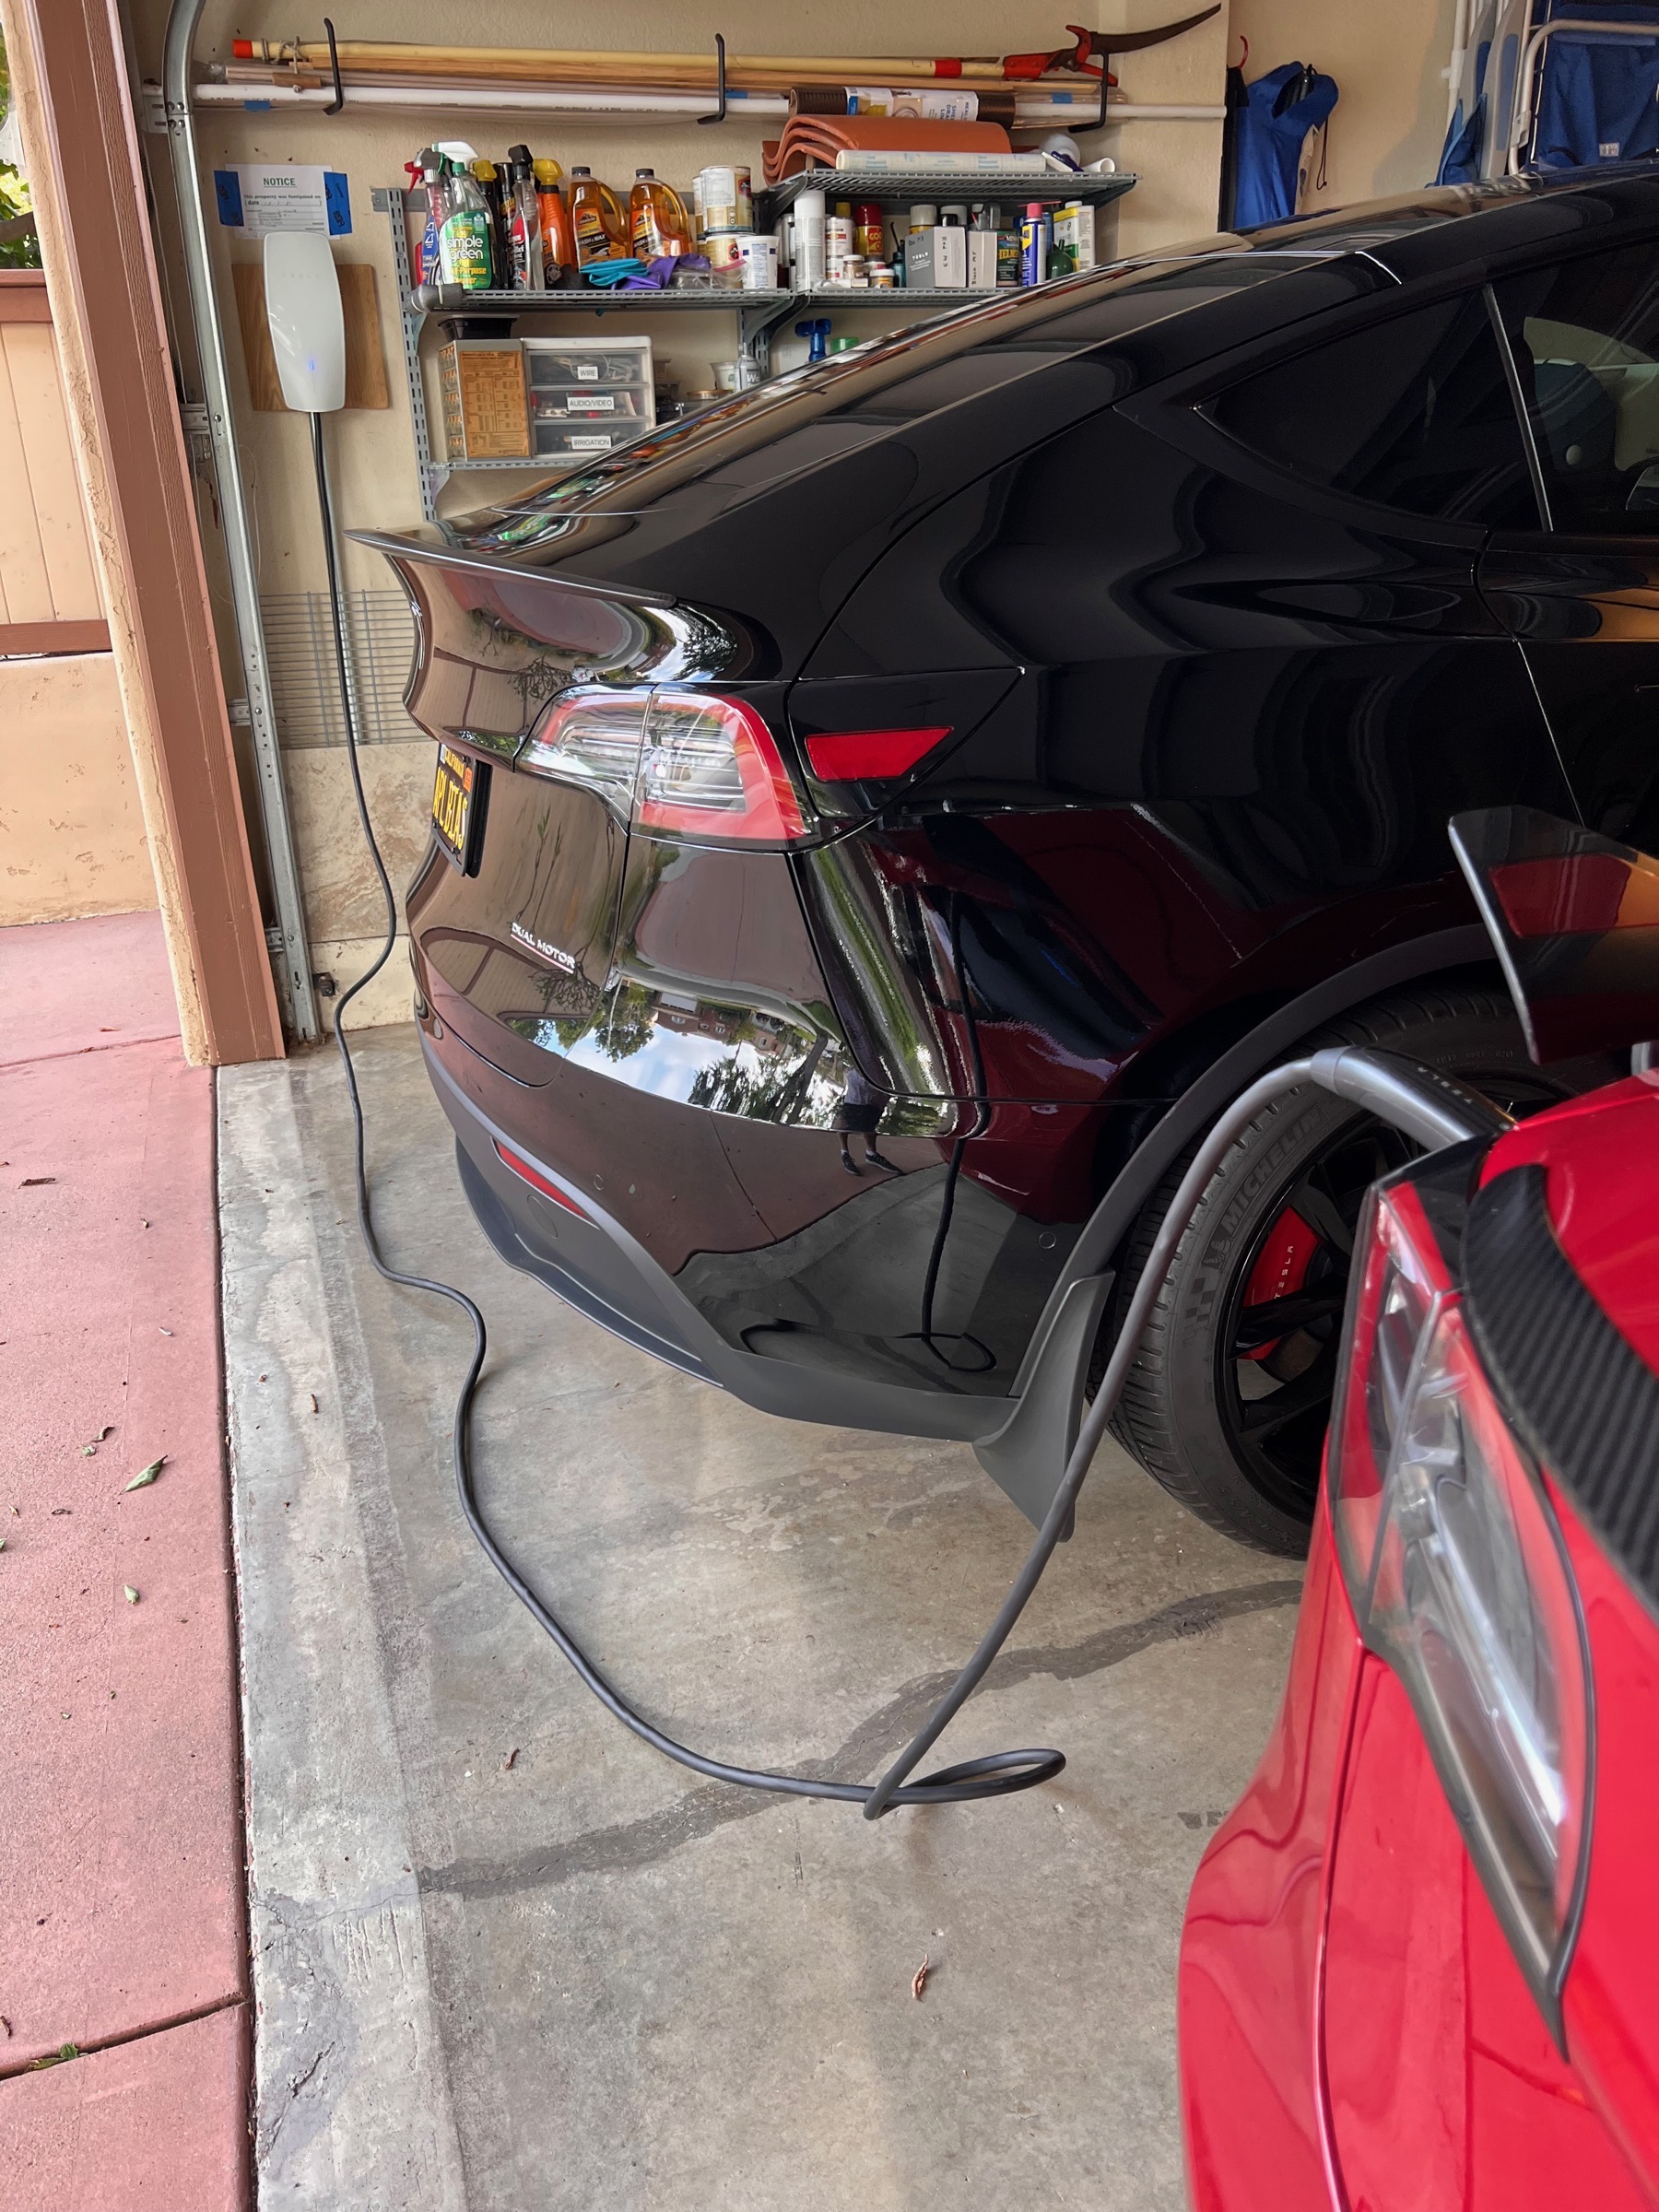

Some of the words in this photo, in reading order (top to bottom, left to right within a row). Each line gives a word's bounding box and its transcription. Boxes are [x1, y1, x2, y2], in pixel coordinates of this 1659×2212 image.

[263, 177, 296, 186] NOTICE
[447, 235, 483, 252] simple
[449, 249, 483, 262] green
[573, 438, 609, 446] IRRIGATION
[512, 922, 535, 946] DUAL
[537, 939, 576, 969] MOTOR
[1220, 1108, 1324, 1233] MICHELIN
